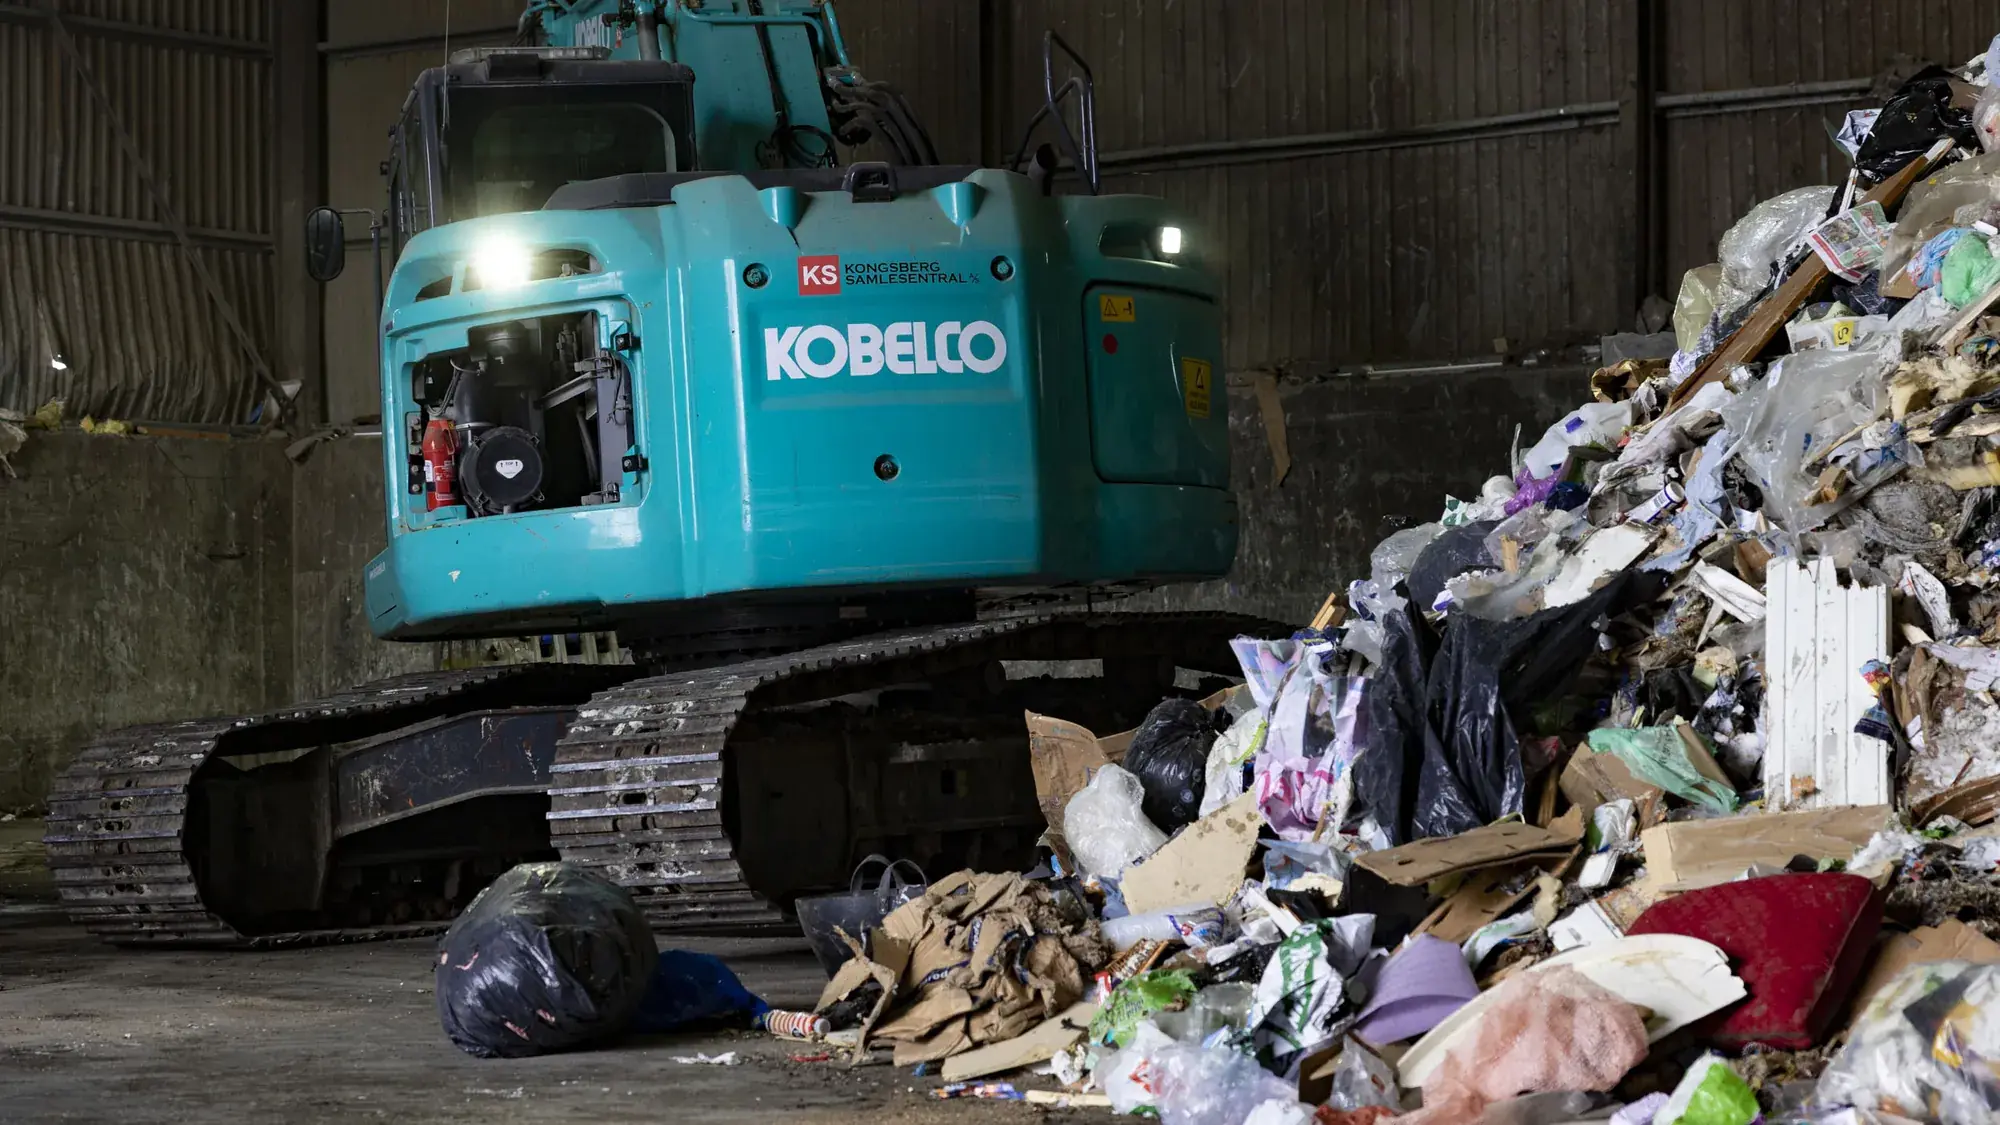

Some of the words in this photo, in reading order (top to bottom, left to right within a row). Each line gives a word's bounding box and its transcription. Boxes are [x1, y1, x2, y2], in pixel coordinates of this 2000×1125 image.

[802, 264, 838, 286] KS
[845, 262, 940, 274] KONGSBERG
[845, 273, 967, 285] SAMLESENTRAL
[764, 320, 1007, 381] KOBELCO
